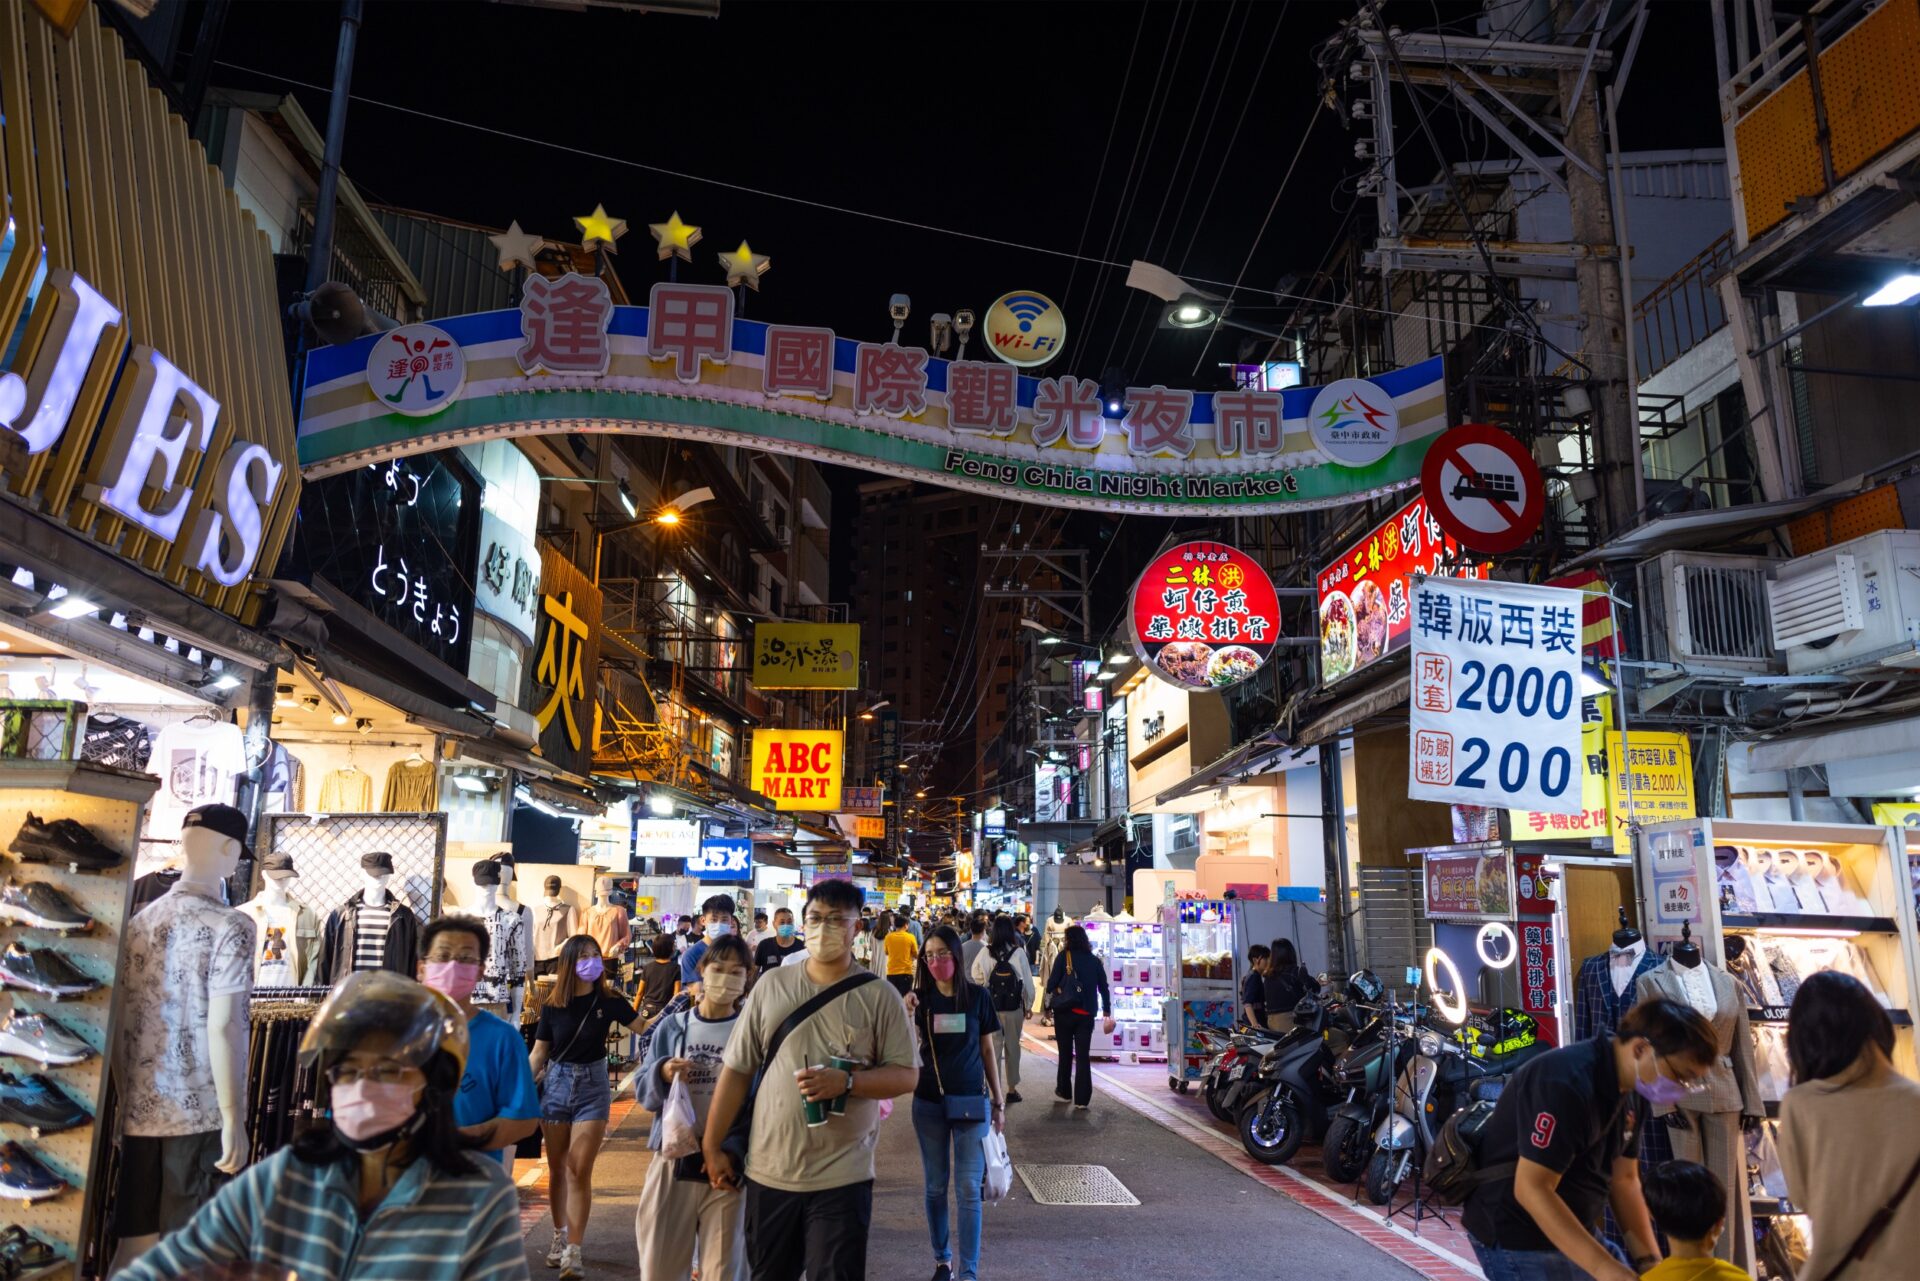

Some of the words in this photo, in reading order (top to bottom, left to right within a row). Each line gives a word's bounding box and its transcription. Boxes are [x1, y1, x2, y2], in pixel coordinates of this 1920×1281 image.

[993, 332, 1056, 352] Wi-Fi
[521, 276, 1285, 455] 逢甲國際觀光夜市
[1330, 430, 1380, 440] 臺中市政府
[944, 451, 1018, 485] Feng
[1023, 460, 1093, 492] Chia
[1100, 474, 1183, 498] Night
[1187, 471, 1298, 498] Market
[1162, 588, 1250, 615] 蚵仔煎
[1865, 580, 1882, 613] 冰點
[1145, 616, 1271, 642] 藥燉排骨
[1417, 590, 1576, 656] 韓版西裝
[1423, 658, 1446, 709] 成套
[1455, 660, 1574, 721] 2000
[763, 742, 832, 774] ABC
[1420, 736, 1450, 757] 防皺
[1420, 758, 1450, 781] 襯衫
[1454, 737, 1572, 798] 200
[762, 777, 831, 799] MART
[1652, 774, 1675, 792] 2,000
[1676, 776, 1685, 791] 人
[1528, 811, 1608, 832] 手機配件
[1669, 884, 1688, 900] 請勿
[1663, 902, 1691, 912] 邊走邊吃
[1525, 927, 1545, 1009] 藥燉排骨
[1530, 1112, 1556, 1149] 9
